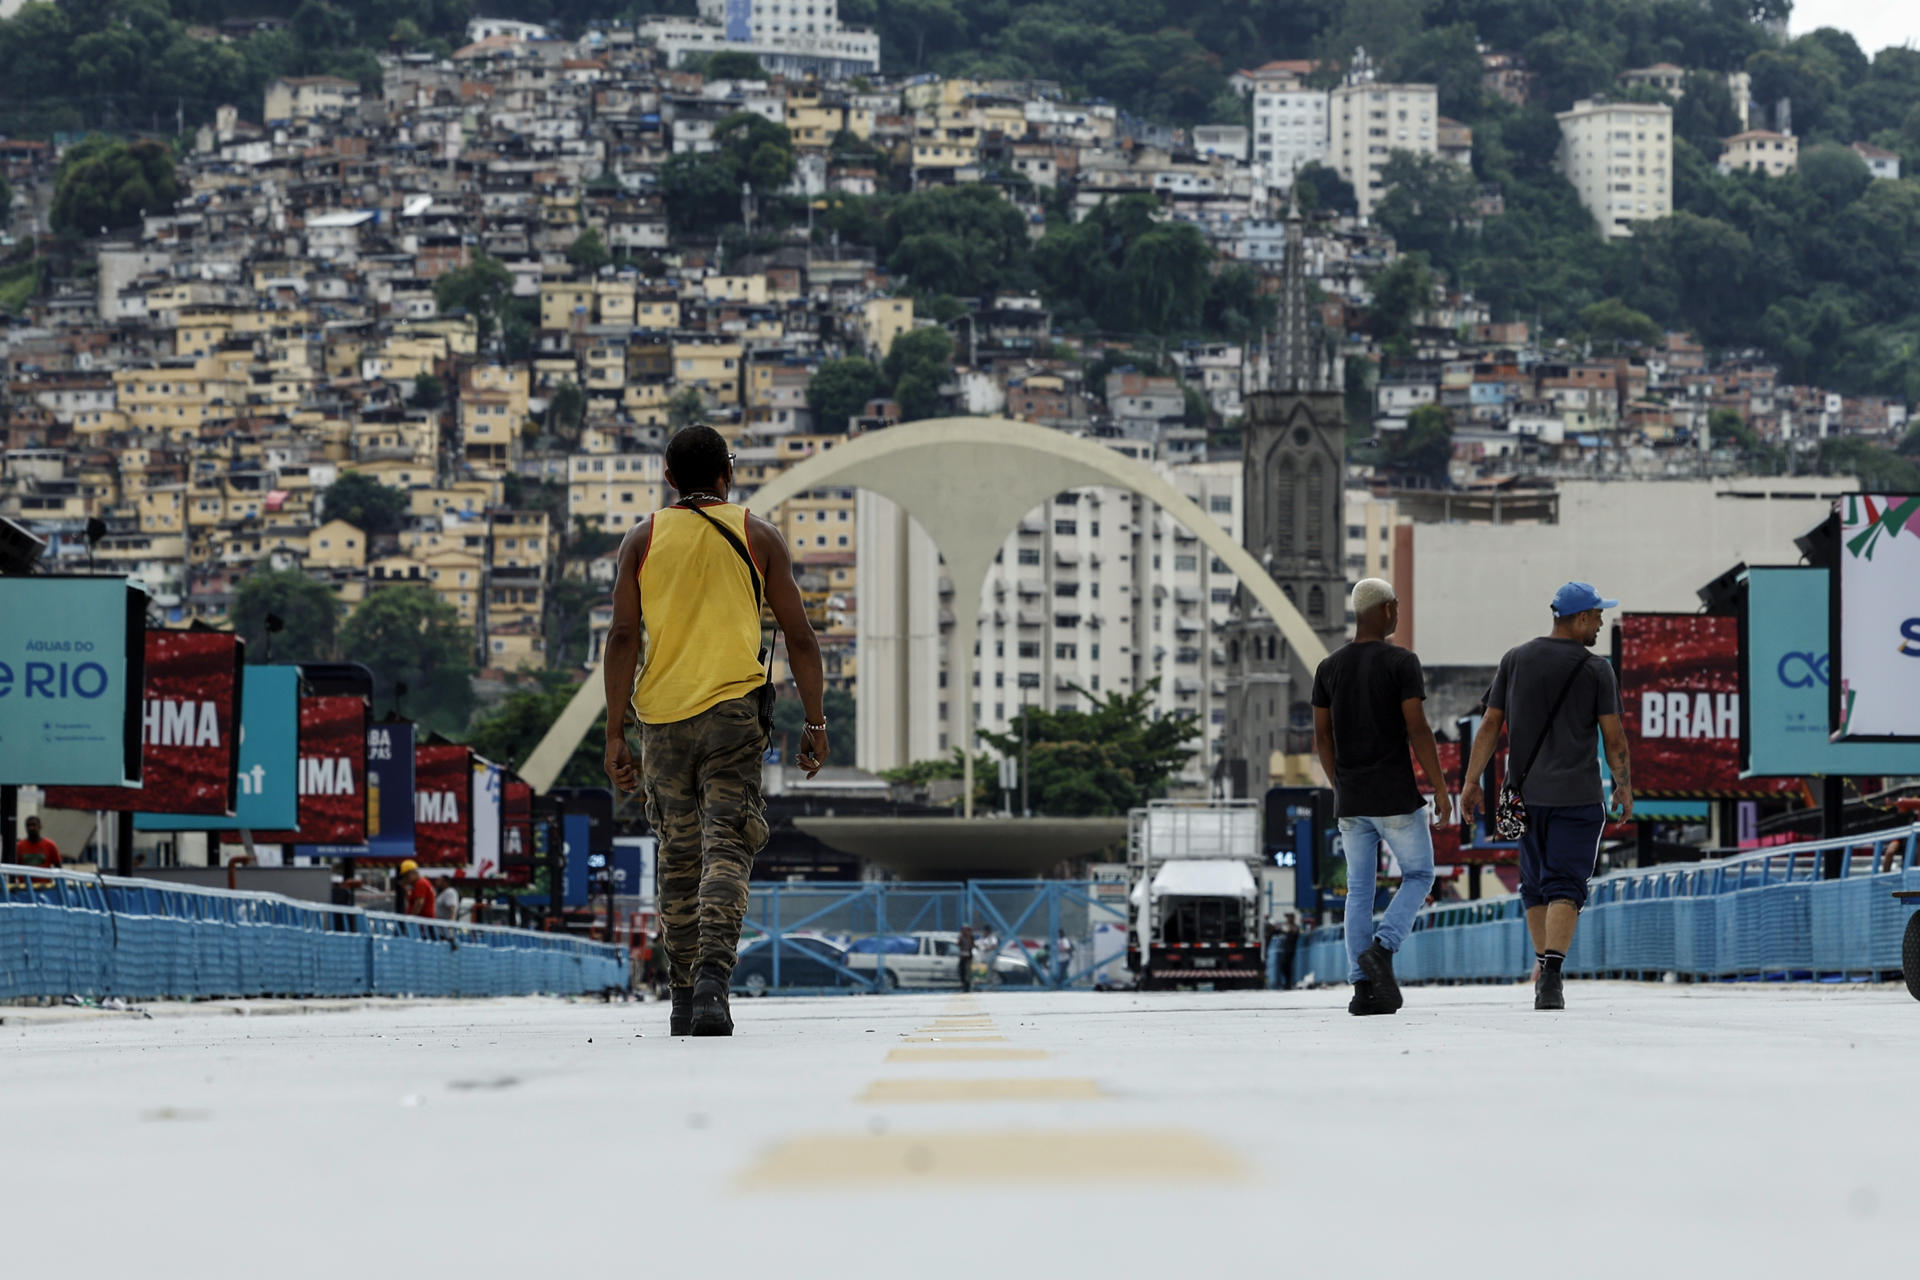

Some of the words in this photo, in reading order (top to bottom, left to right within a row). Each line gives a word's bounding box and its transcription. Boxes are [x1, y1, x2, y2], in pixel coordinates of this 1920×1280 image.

[26, 638, 71, 652] ÁGUAS
[74, 641, 94, 652] DO
[25, 661, 108, 698] RIO
[142, 699, 220, 747] HMA
[1641, 691, 1739, 739] BRAH
